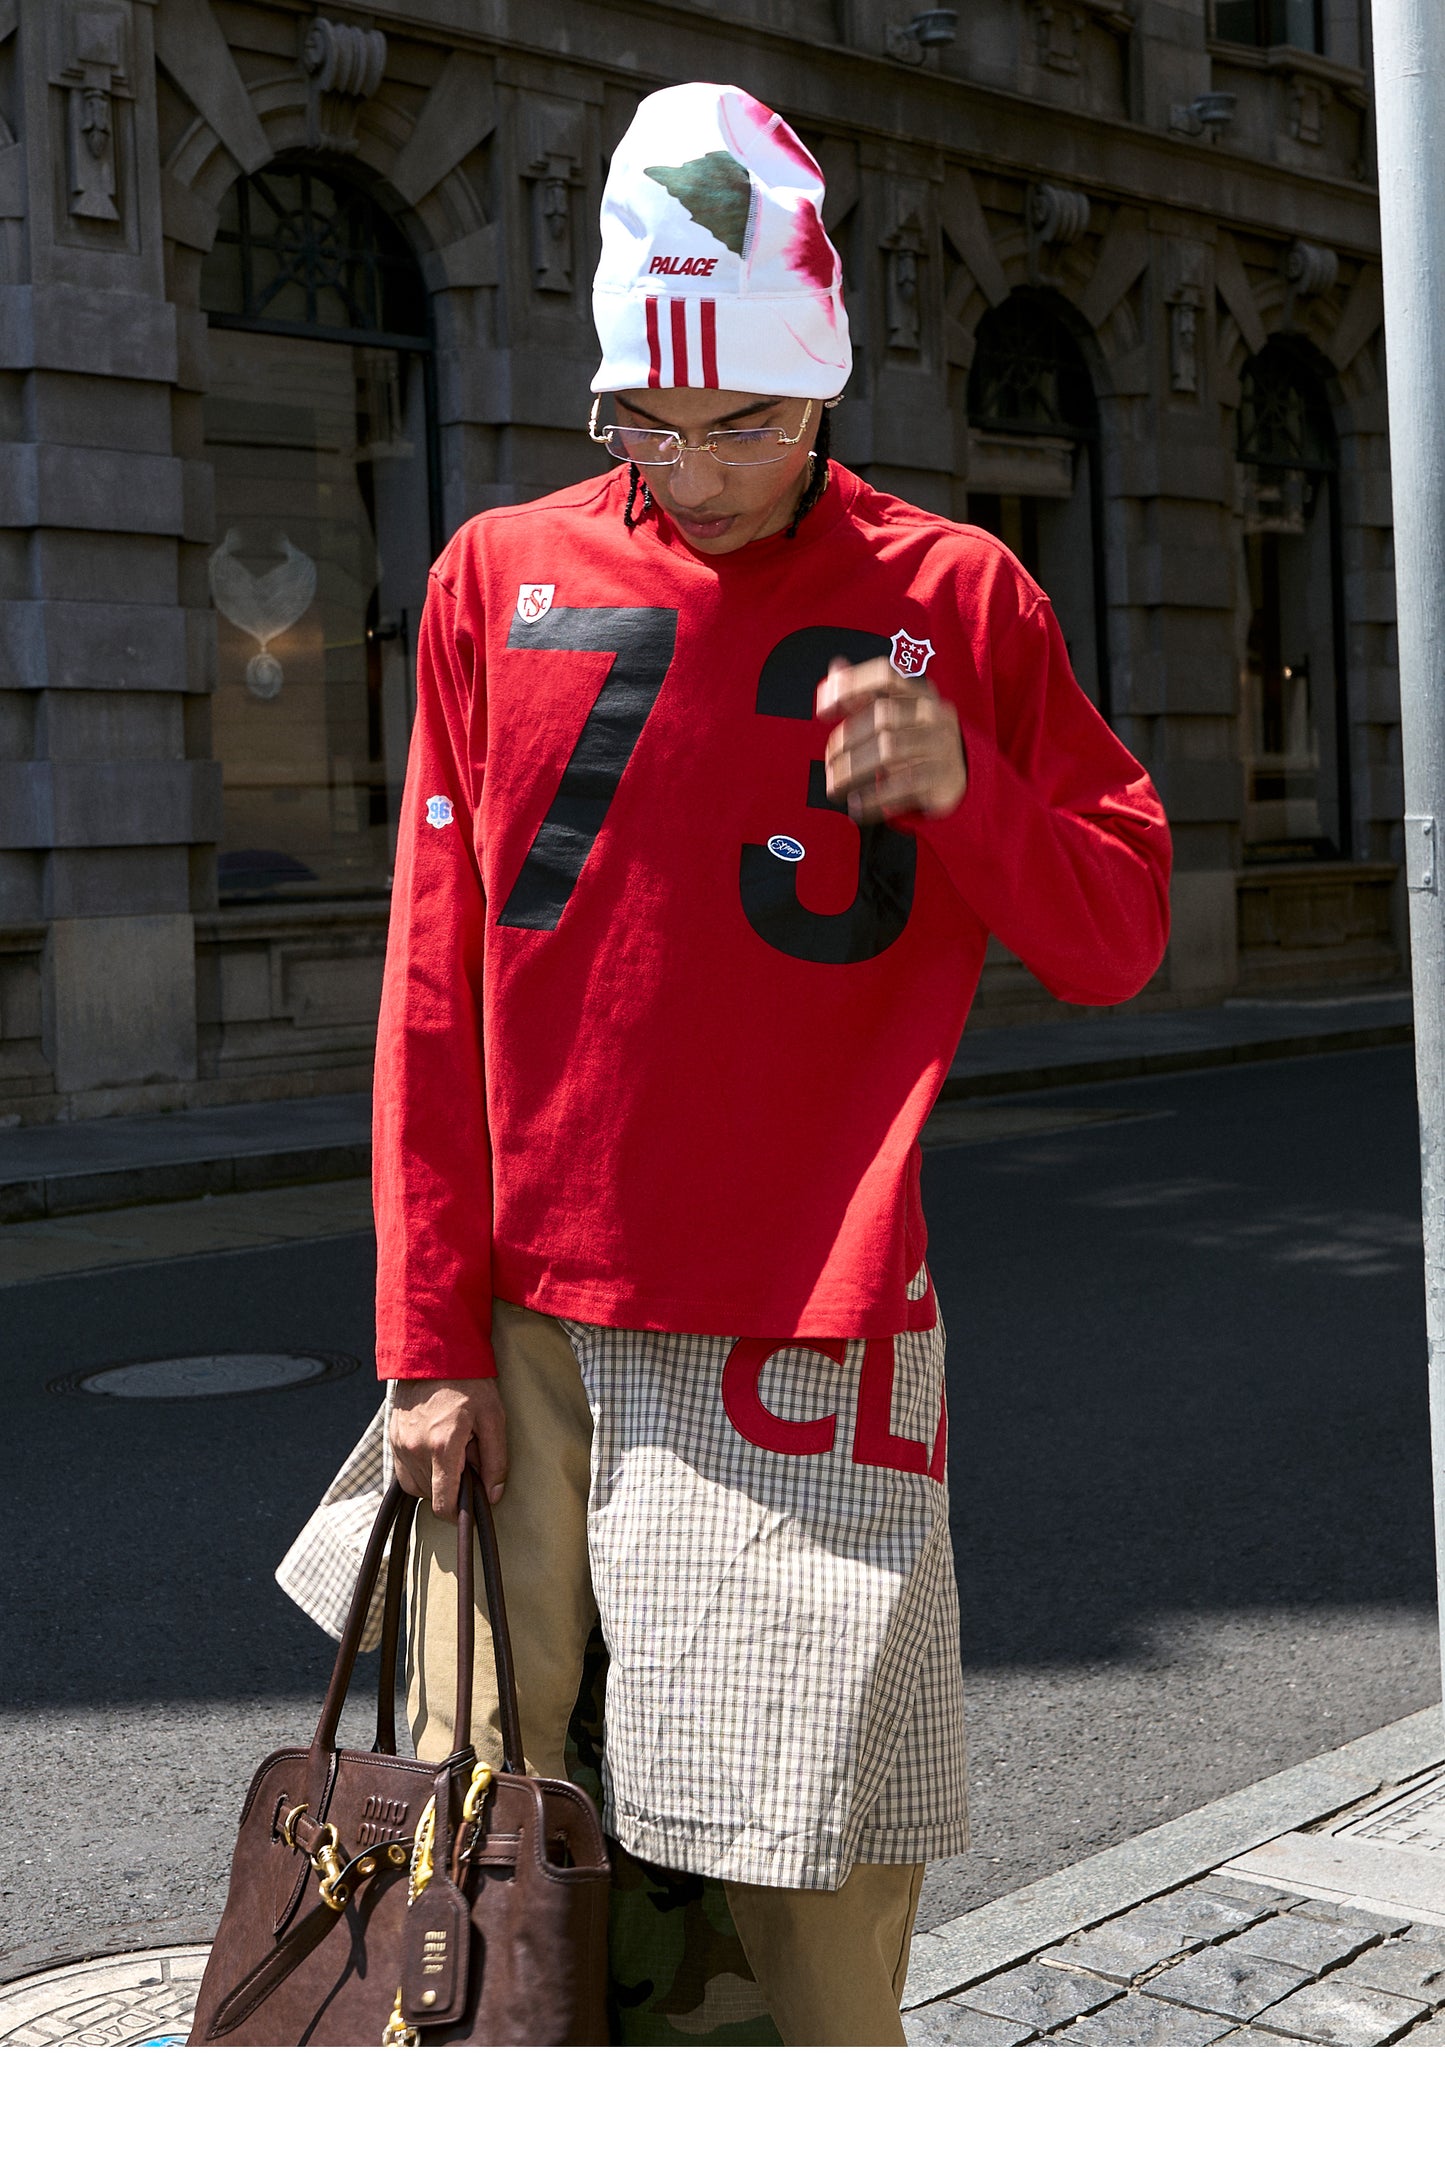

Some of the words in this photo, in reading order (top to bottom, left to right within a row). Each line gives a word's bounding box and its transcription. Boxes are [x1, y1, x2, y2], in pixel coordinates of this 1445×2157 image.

[648, 256, 719, 277] PALACE
[898, 650, 918, 673] ST
[430, 802, 450, 819] 96
[721, 1337, 947, 1485] CL
